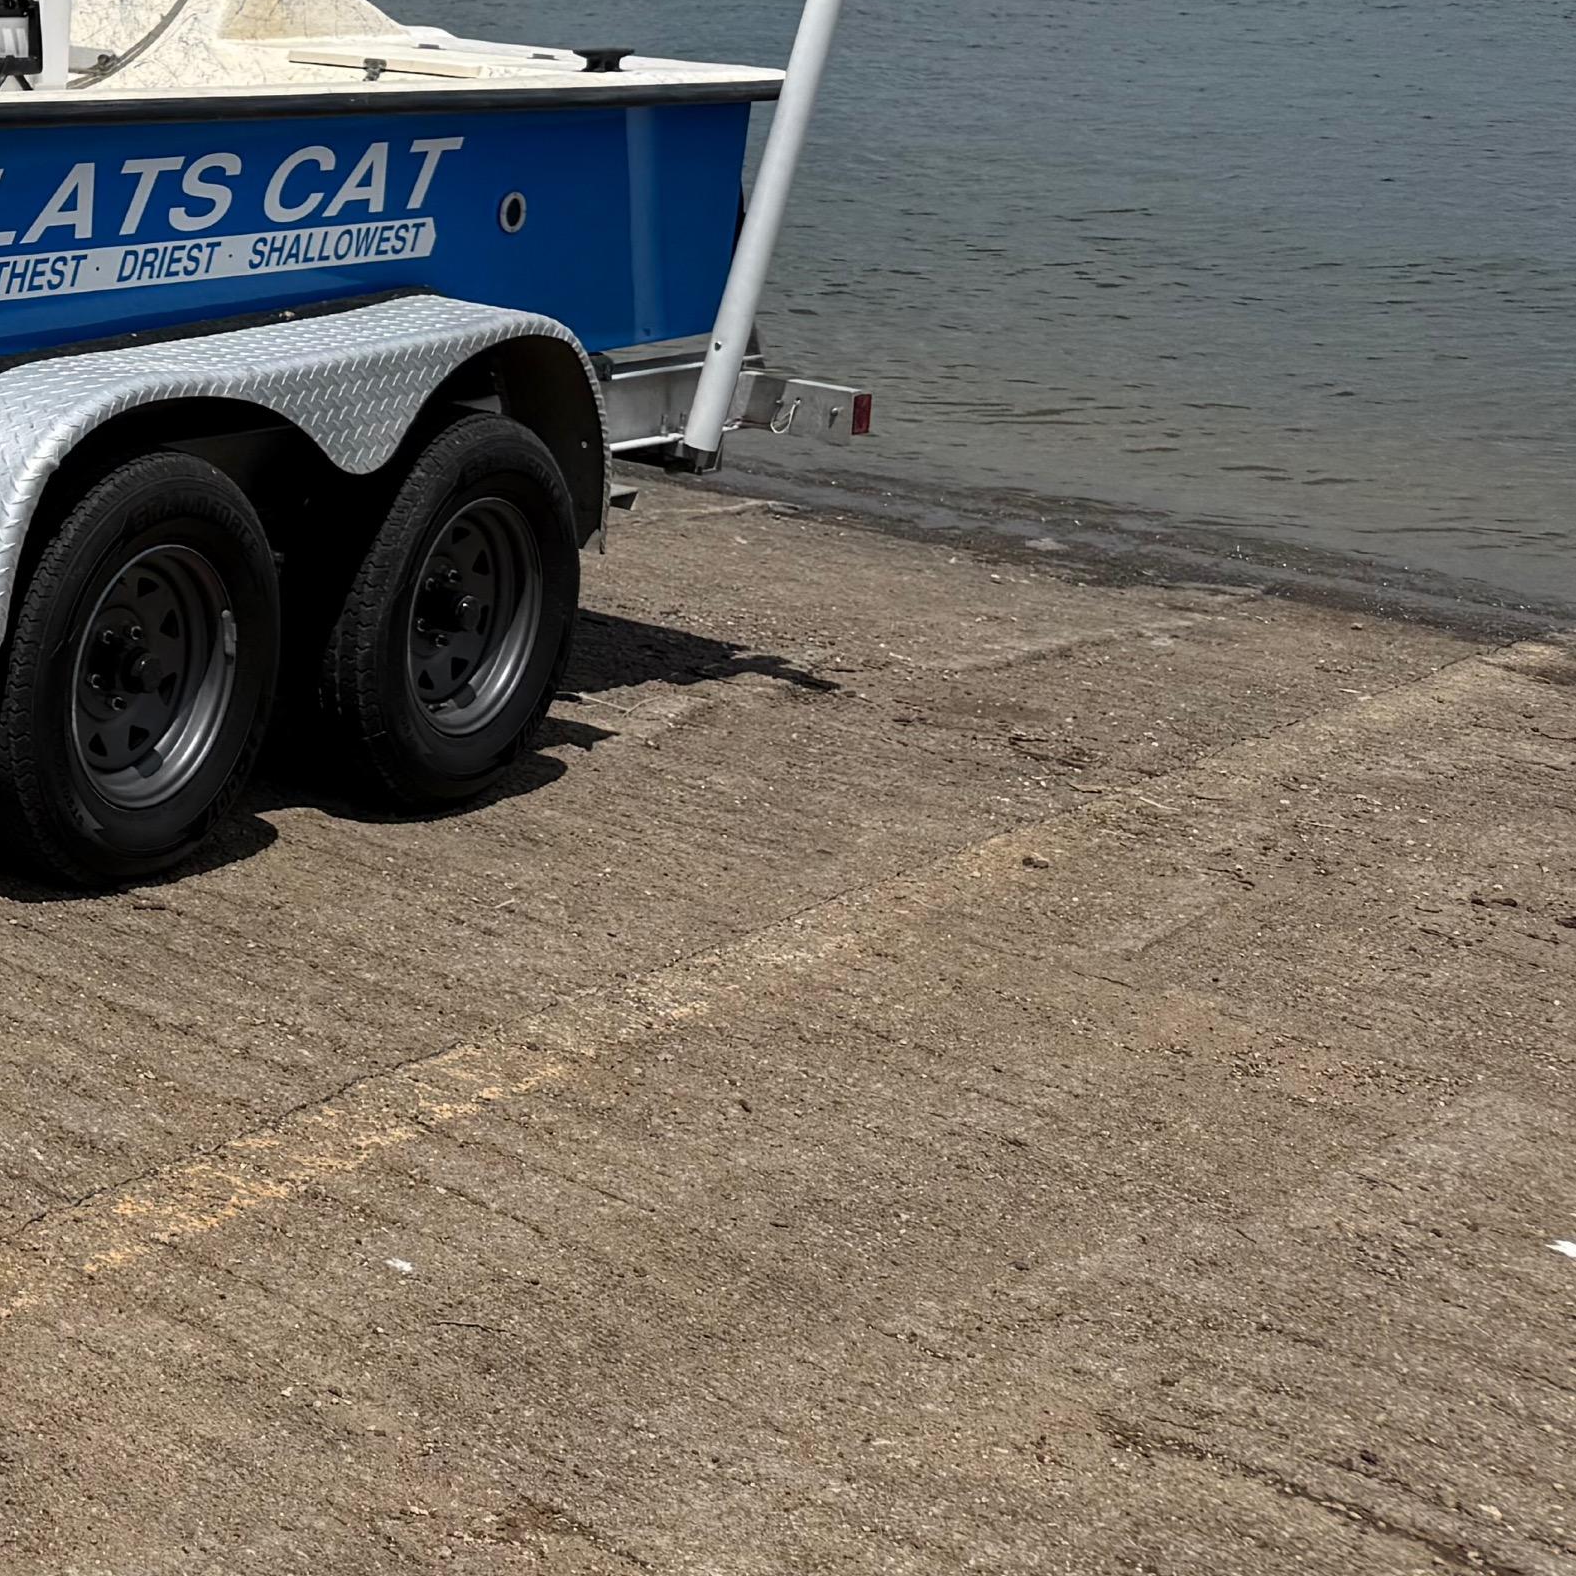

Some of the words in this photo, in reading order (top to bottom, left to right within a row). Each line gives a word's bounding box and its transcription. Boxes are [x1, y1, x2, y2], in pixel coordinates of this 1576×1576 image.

[263, 137, 464, 222] CAT
[116, 242, 222, 283] DRIEST
[248, 223, 427, 267] SHALLOWEST
